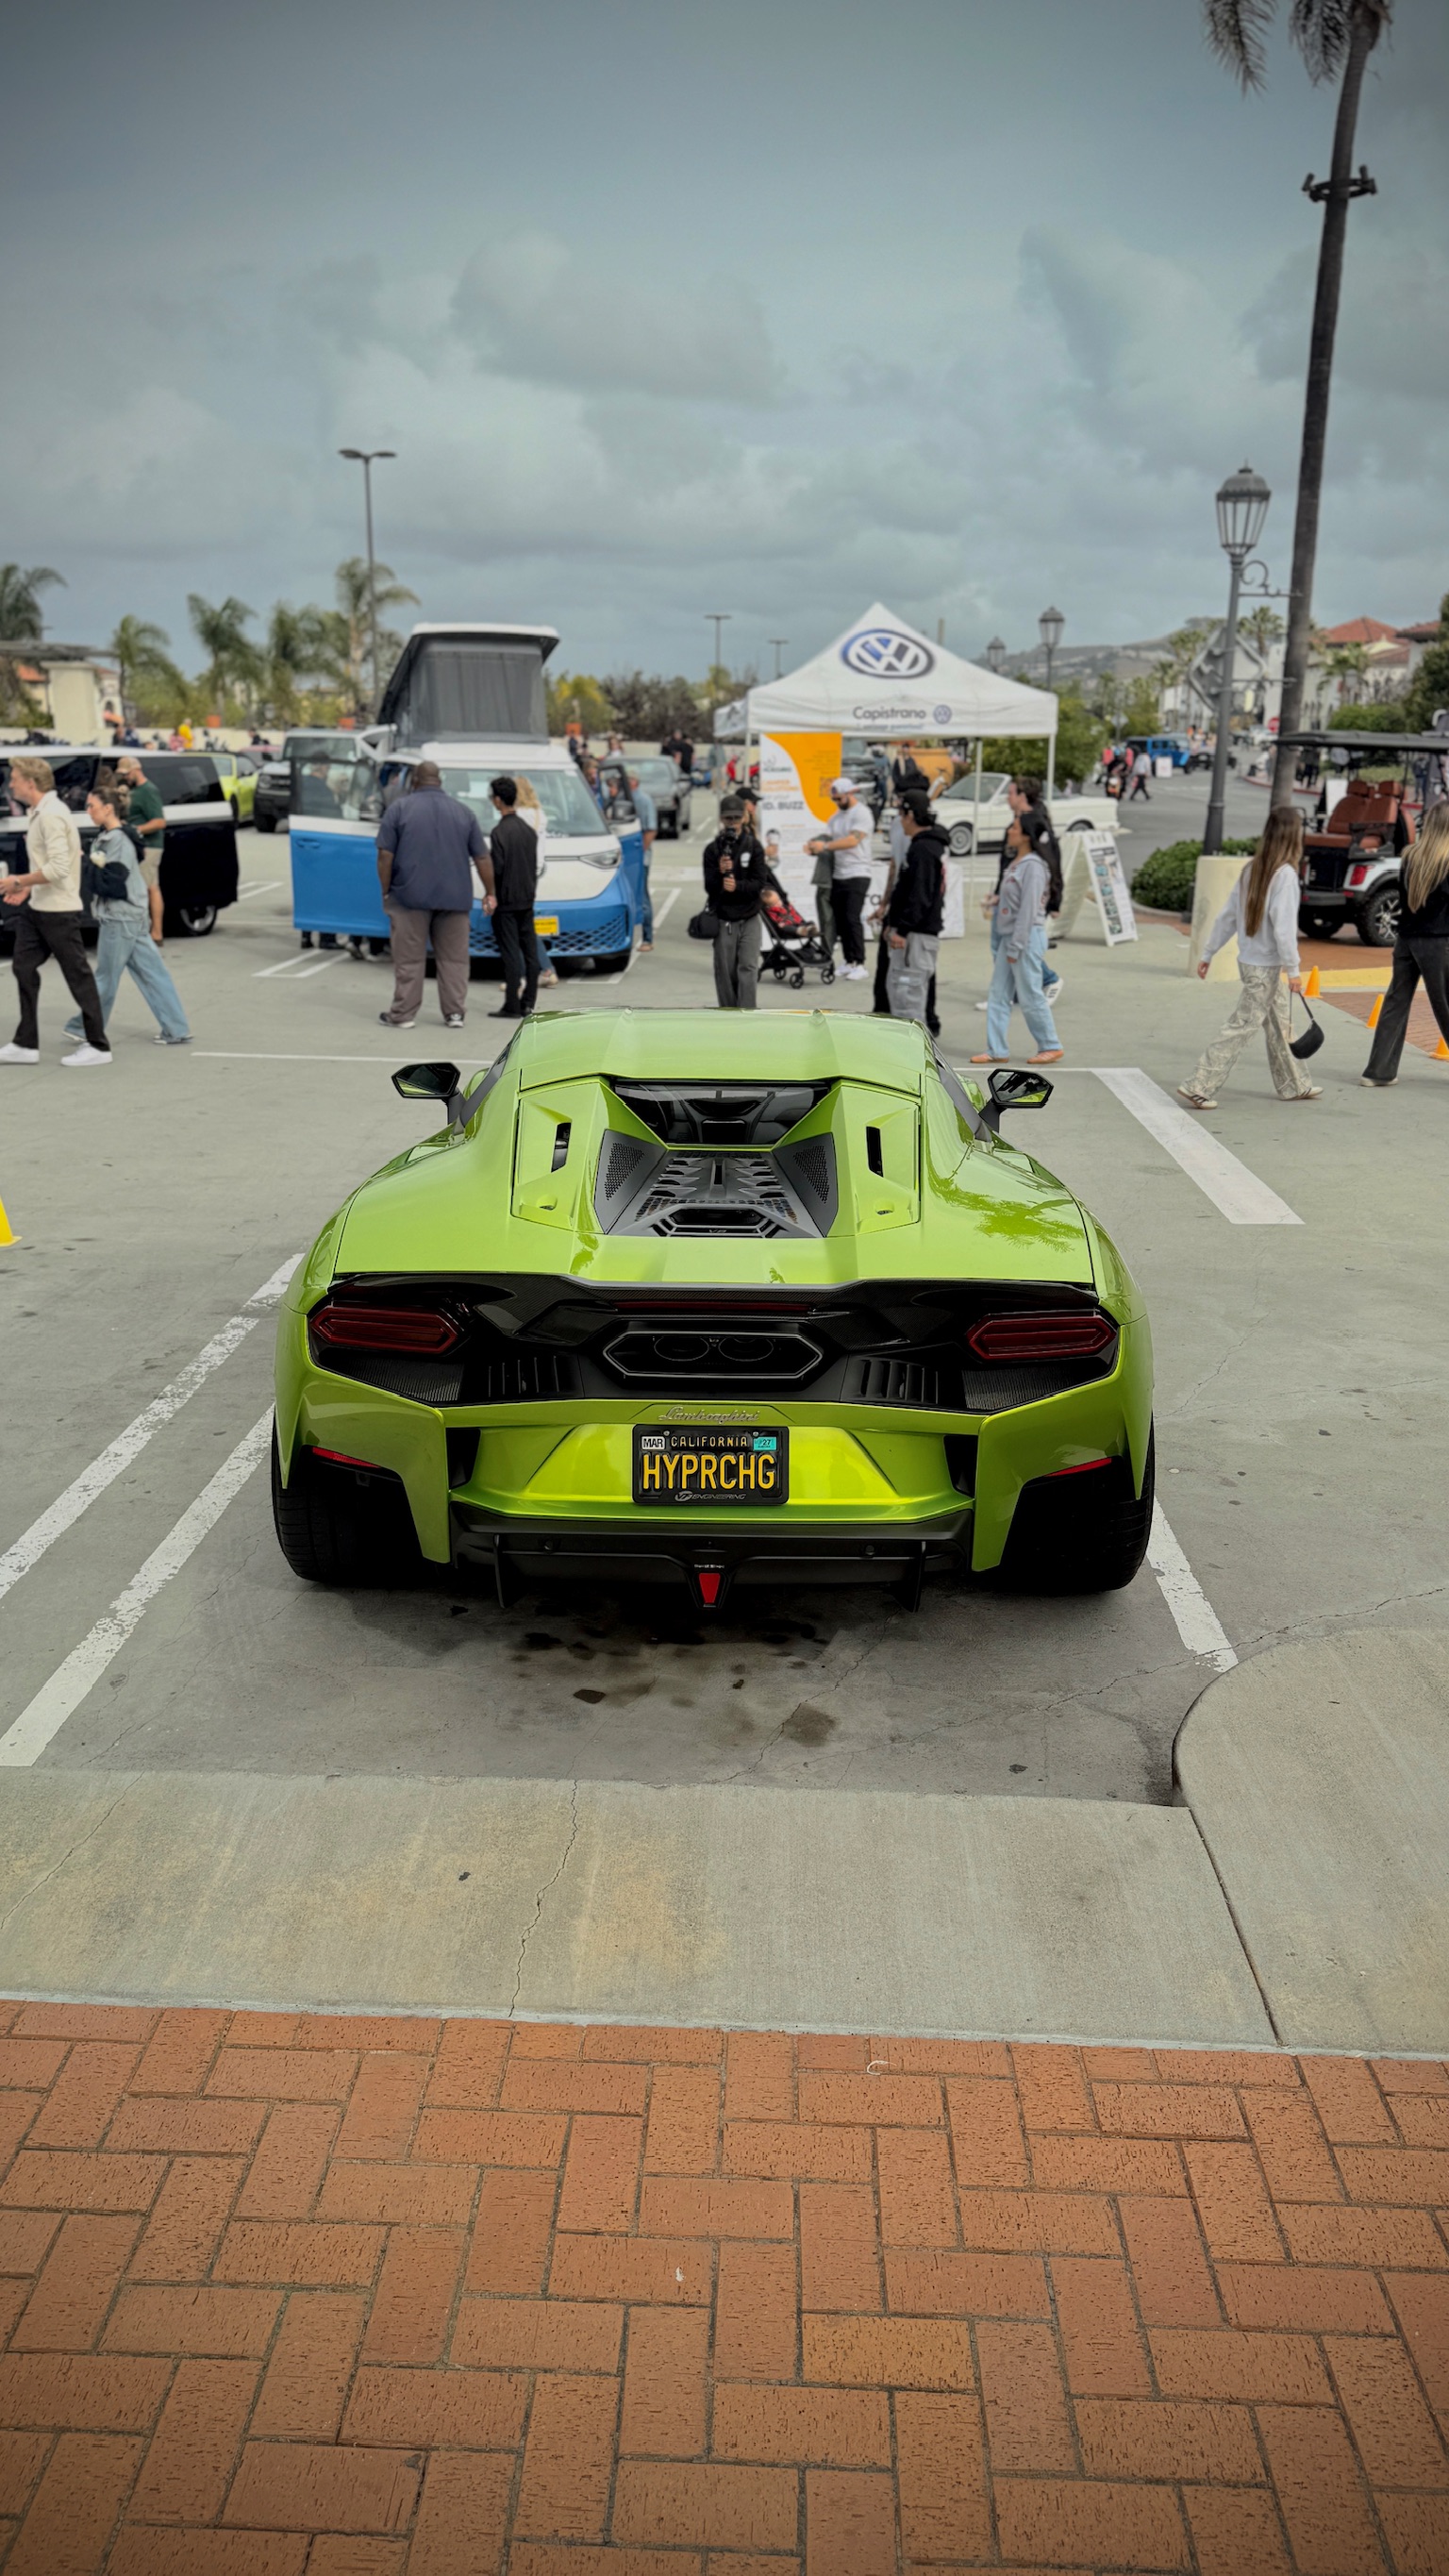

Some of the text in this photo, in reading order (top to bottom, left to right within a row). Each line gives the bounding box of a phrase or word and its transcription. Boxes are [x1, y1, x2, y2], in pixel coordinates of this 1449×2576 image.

[841, 628, 934, 678] VW
[852, 706, 926, 721] Capistrano
[777, 801, 804, 810] BUZZ
[658, 1406, 760, 1424] Lamborghini
[642, 1438, 663, 1448] MAR
[671, 1436, 747, 1447] CALIFORNIA
[642, 1454, 775, 1490] HYPRCHG
